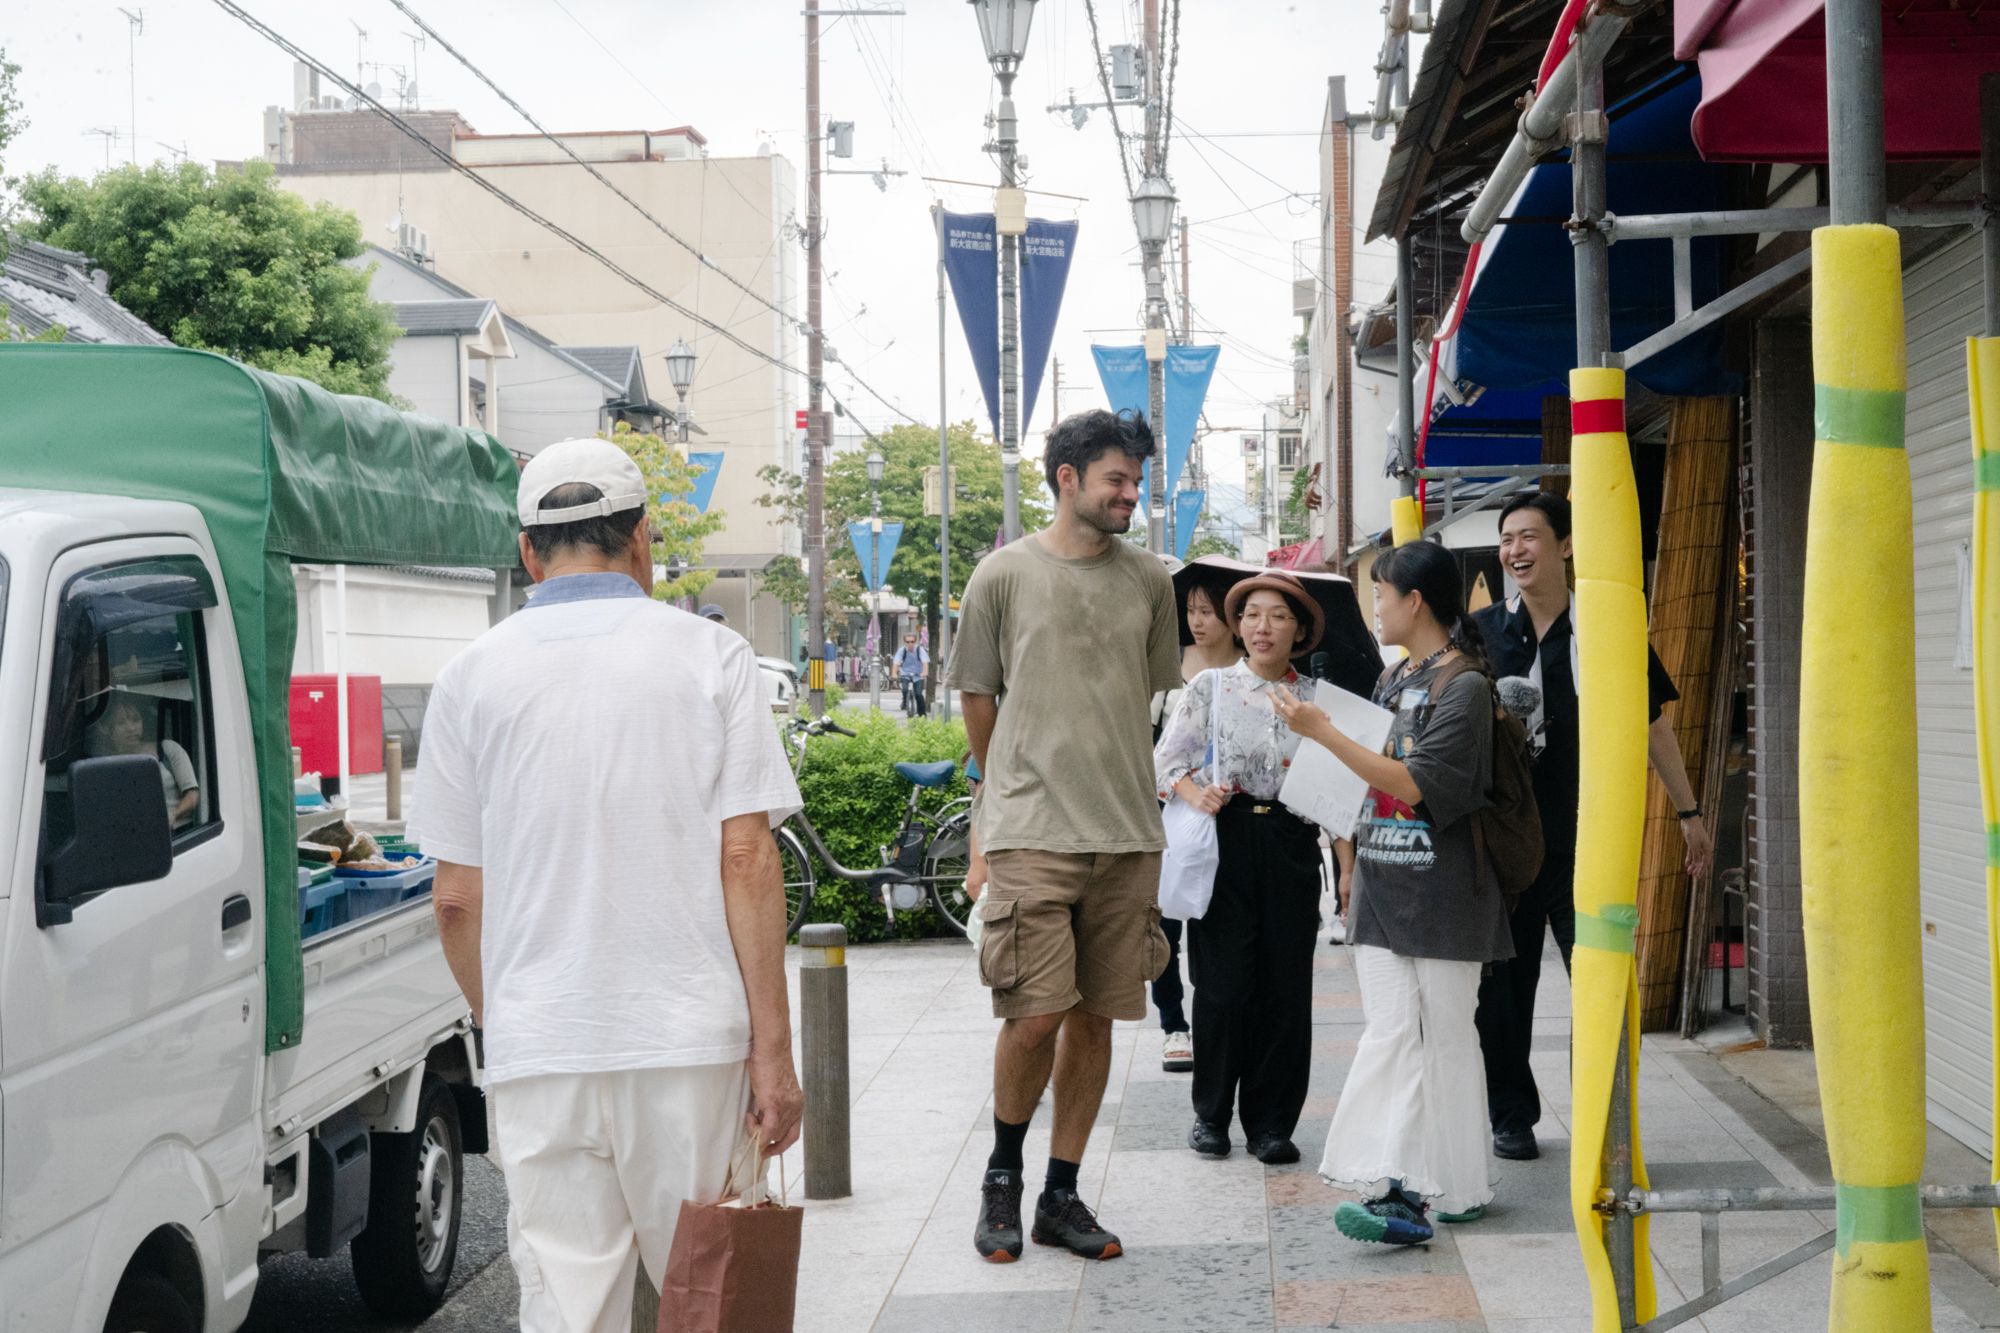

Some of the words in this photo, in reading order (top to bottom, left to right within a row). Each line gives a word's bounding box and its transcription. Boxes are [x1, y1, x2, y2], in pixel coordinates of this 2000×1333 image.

[949, 239, 993, 251] 新大宮商店街
